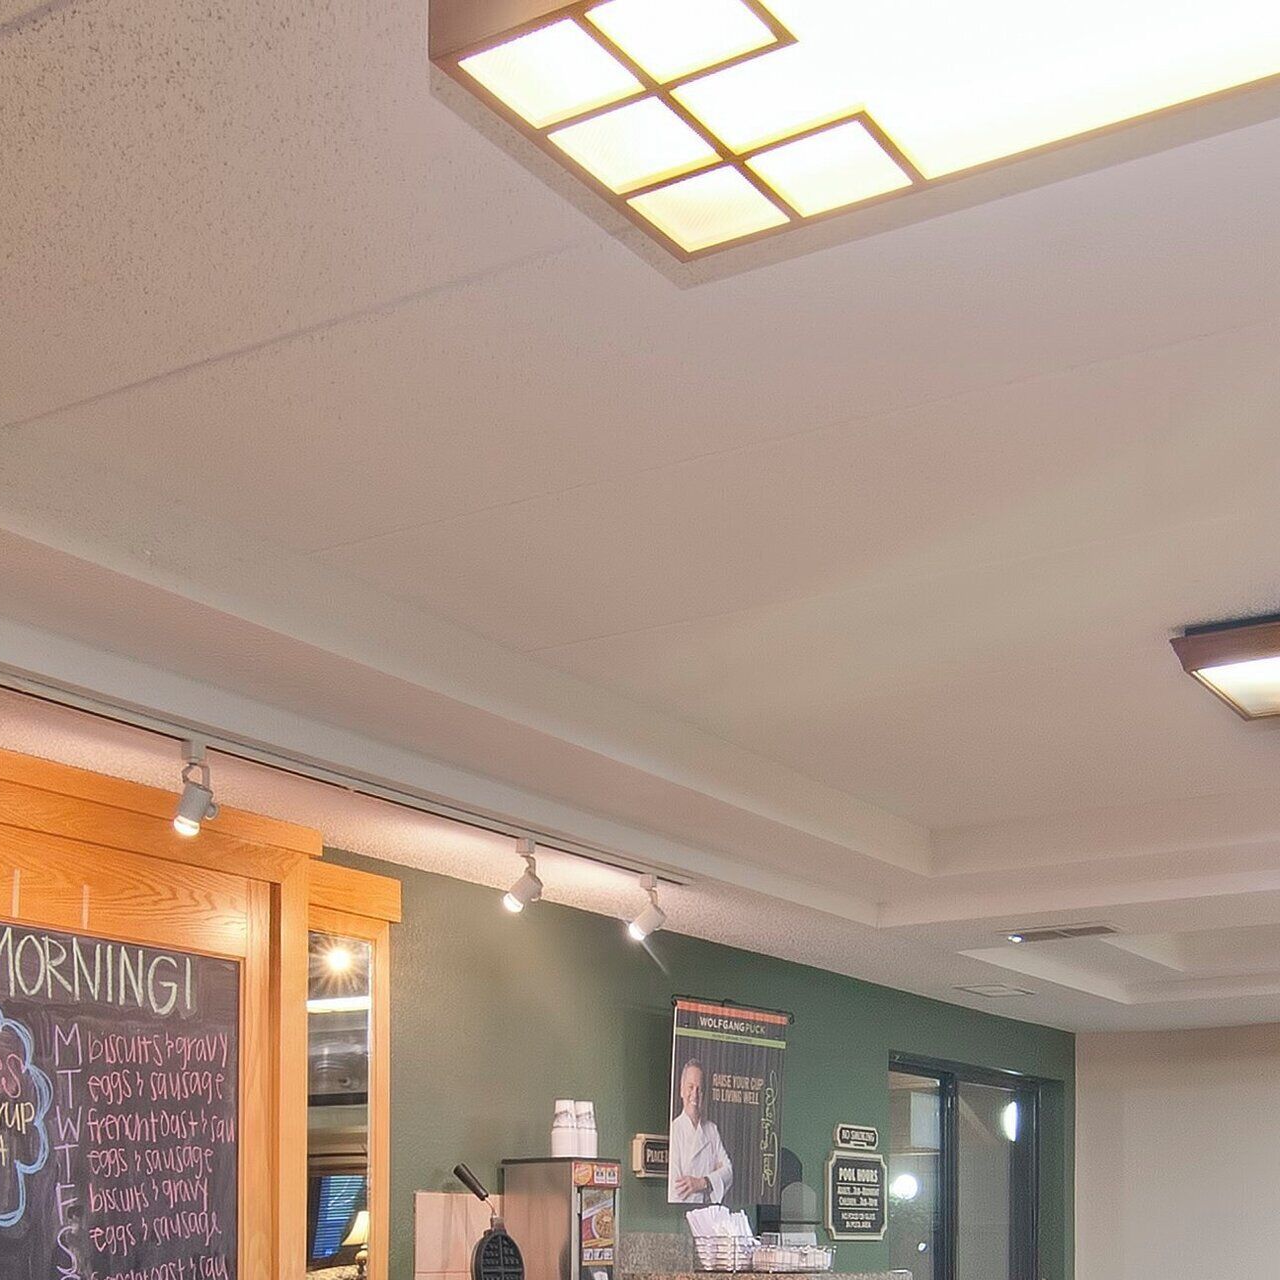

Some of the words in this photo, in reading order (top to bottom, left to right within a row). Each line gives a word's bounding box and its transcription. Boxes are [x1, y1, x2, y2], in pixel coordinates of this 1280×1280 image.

[54, 1022, 83, 1067] M
[88, 1031, 163, 1067] biscuits
[175, 1032, 228, 1071] gravy
[56, 1068, 82, 1109] T
[86, 1069, 132, 1105] eggs
[150, 1070, 225, 1105] sausage
[56, 1105, 83, 1142] W
[54, 1142, 80, 1184] T
[86, 1148, 128, 1178] eggs
[144, 1145, 214, 1180] sausage
[55, 1181, 78, 1226] F
[89, 1182, 150, 1213] biscuits
[161, 1176, 209, 1213] gravy
[56, 1224, 78, 1274] S
[89, 1221, 136, 1257] eggs
[152, 1210, 223, 1247] sausage
